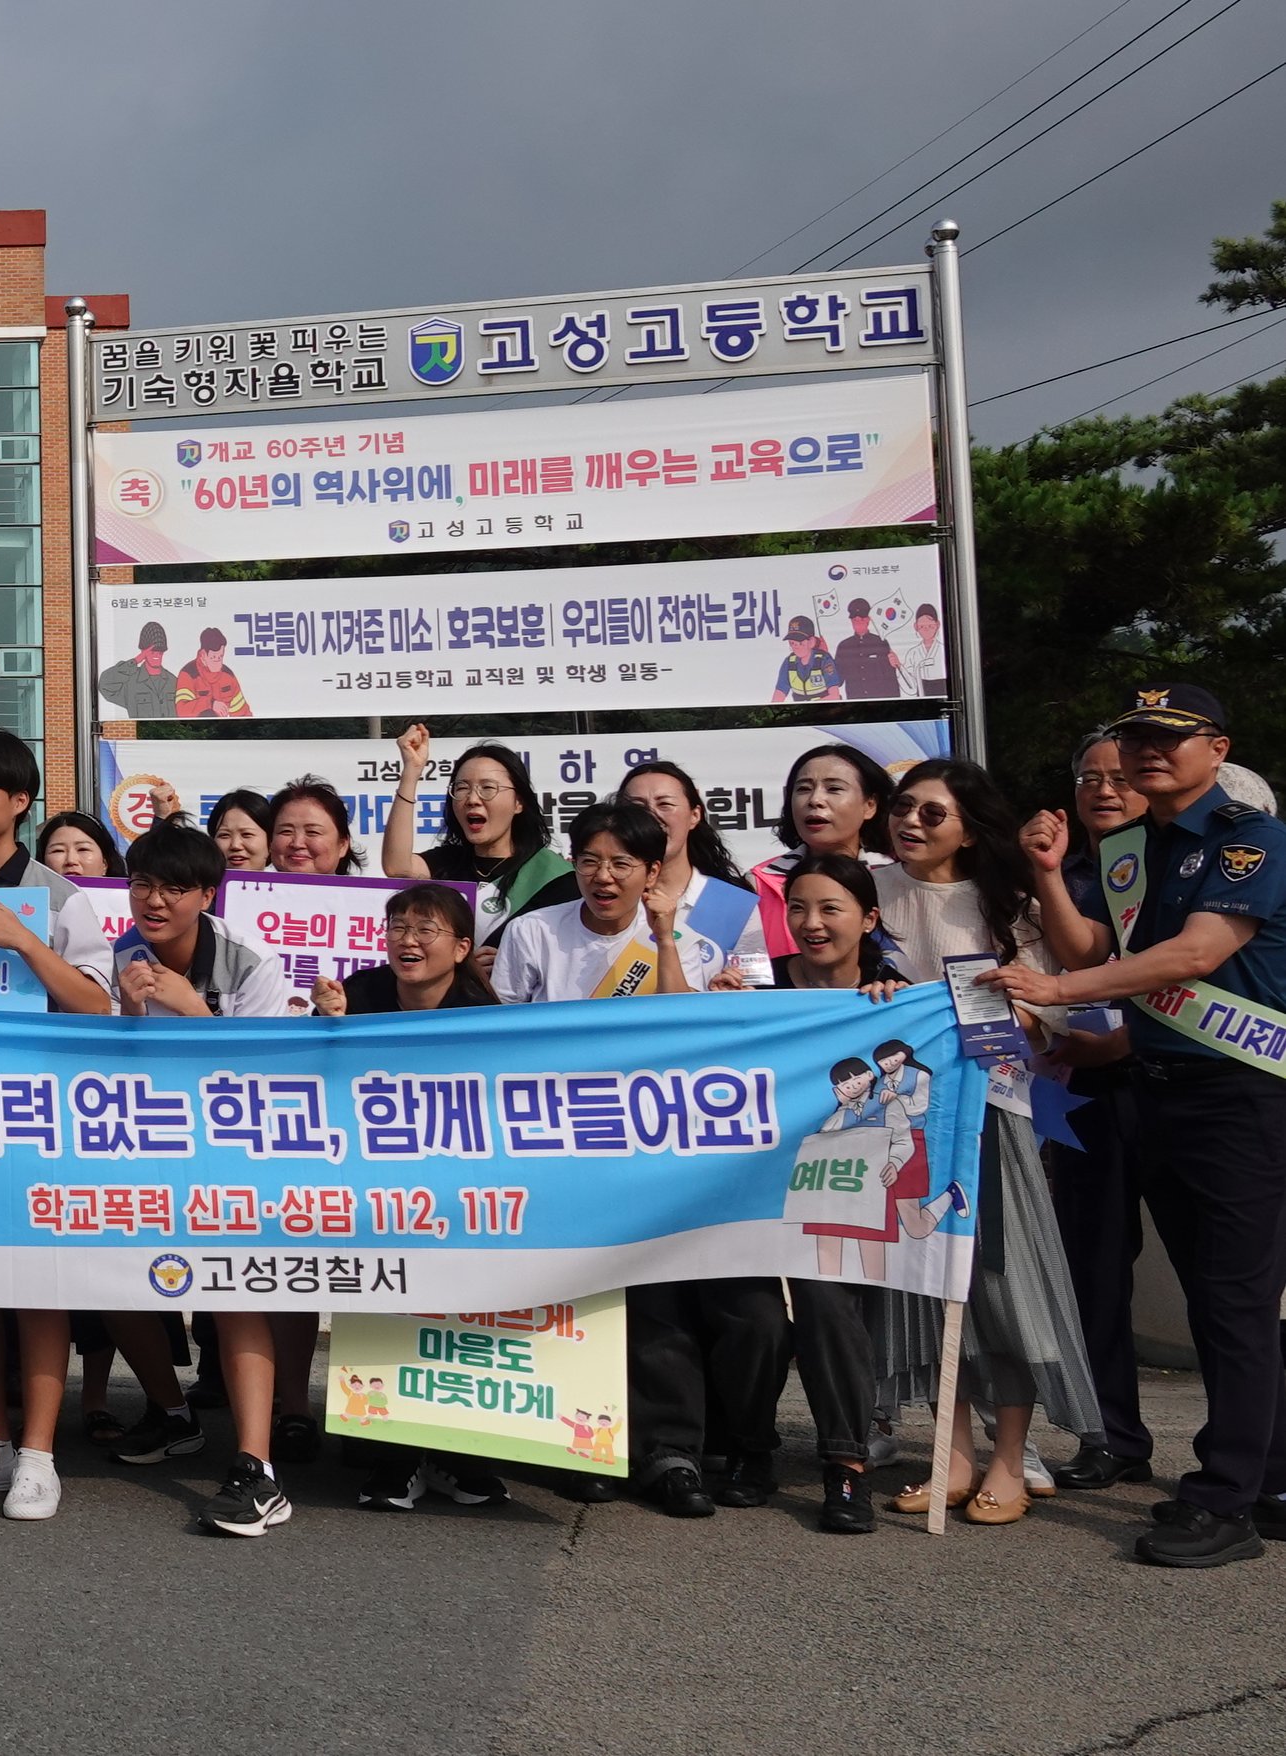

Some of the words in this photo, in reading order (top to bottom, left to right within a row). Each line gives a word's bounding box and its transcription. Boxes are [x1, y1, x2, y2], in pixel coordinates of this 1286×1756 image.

[101, 339, 161, 371] 꿈을
[174, 333, 236, 364] 키워
[248, 330, 277, 360] 꽃
[291, 323, 388, 355] 피우는
[478, 284, 928, 374] 고성고등학교
[102, 355, 388, 409] 기숙형자율학교
[207, 441, 255, 463] 개교
[268, 435, 345, 460] 60주년
[359, 432, 404, 454] 기념
[120, 479, 151, 507] 축
[469, 455, 574, 497] 미래를
[586, 448, 698, 489] 깨우는
[852, 564, 900, 576] 국가보훈부
[111, 598, 139, 609] 6월은
[142, 597, 194, 609] 호국보훈의
[196, 597, 207, 608] 달
[234, 610, 316, 657] 그분들이
[321, 607, 384, 655] 지켜준
[390, 605, 433, 653] 미소
[562, 596, 654, 648] 우리들이
[658, 593, 727, 642] 전하는
[734, 590, 781, 639] 감사
[466, 667, 524, 688] 교직원
[536, 667, 555, 683] 및
[566, 664, 606, 682] 학생
[257, 912, 335, 948] 오늘의
[74, 1077, 188, 1151] 없는
[206, 1077, 341, 1157] 학교,
[359, 1077, 486, 1153] 함께
[503, 1073, 776, 1151] 만들어요!
[789, 1158, 869, 1191] 예방
[31, 1187, 171, 1231] 학교폭력
[372, 1191, 448, 1238] 112,
[463, 1190, 527, 1231] 117
[201, 1256, 407, 1295] 고성경찰서
[418, 1327, 534, 1373] 마음도
[398, 1366, 554, 1419] 따뜻하게
